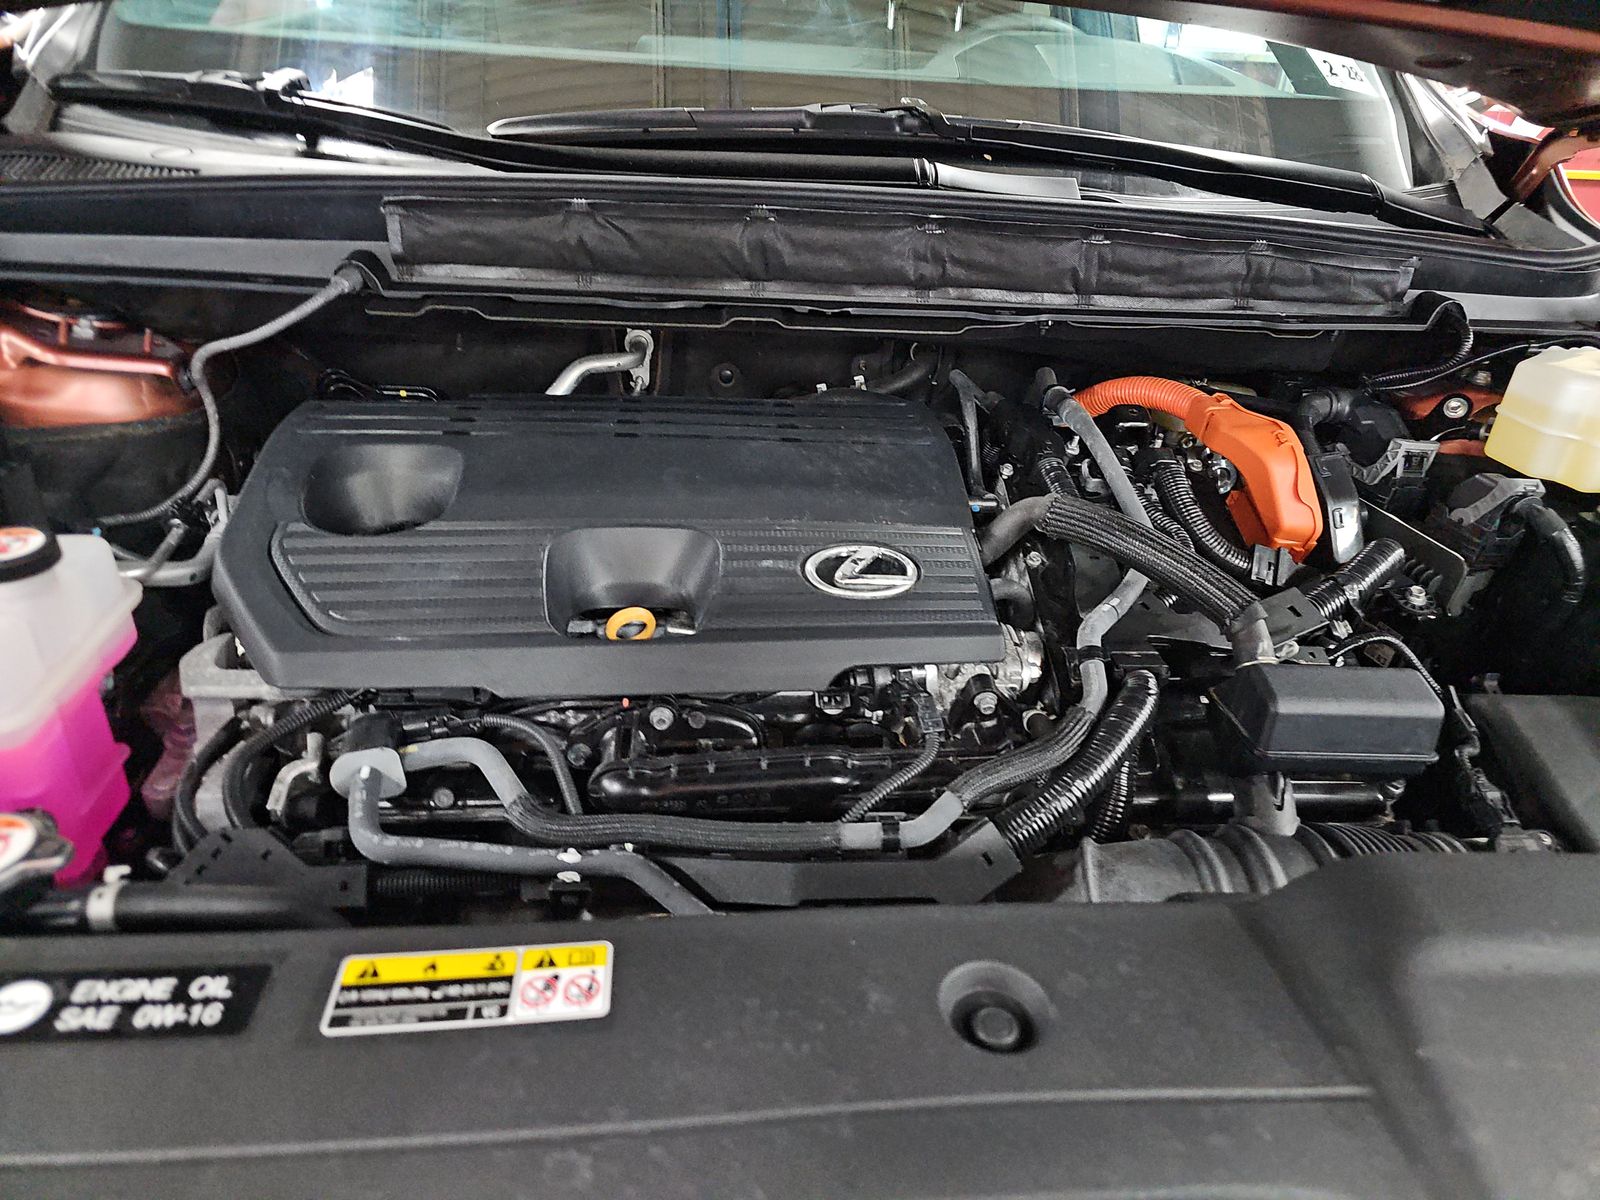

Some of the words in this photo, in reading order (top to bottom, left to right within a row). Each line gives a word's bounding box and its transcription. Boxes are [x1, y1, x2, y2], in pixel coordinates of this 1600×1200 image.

[1323, 59, 1338, 77] 2
[70, 977, 178, 1003] ENGINE
[188, 975, 232, 1000] OIL
[54, 1004, 122, 1032] SAE
